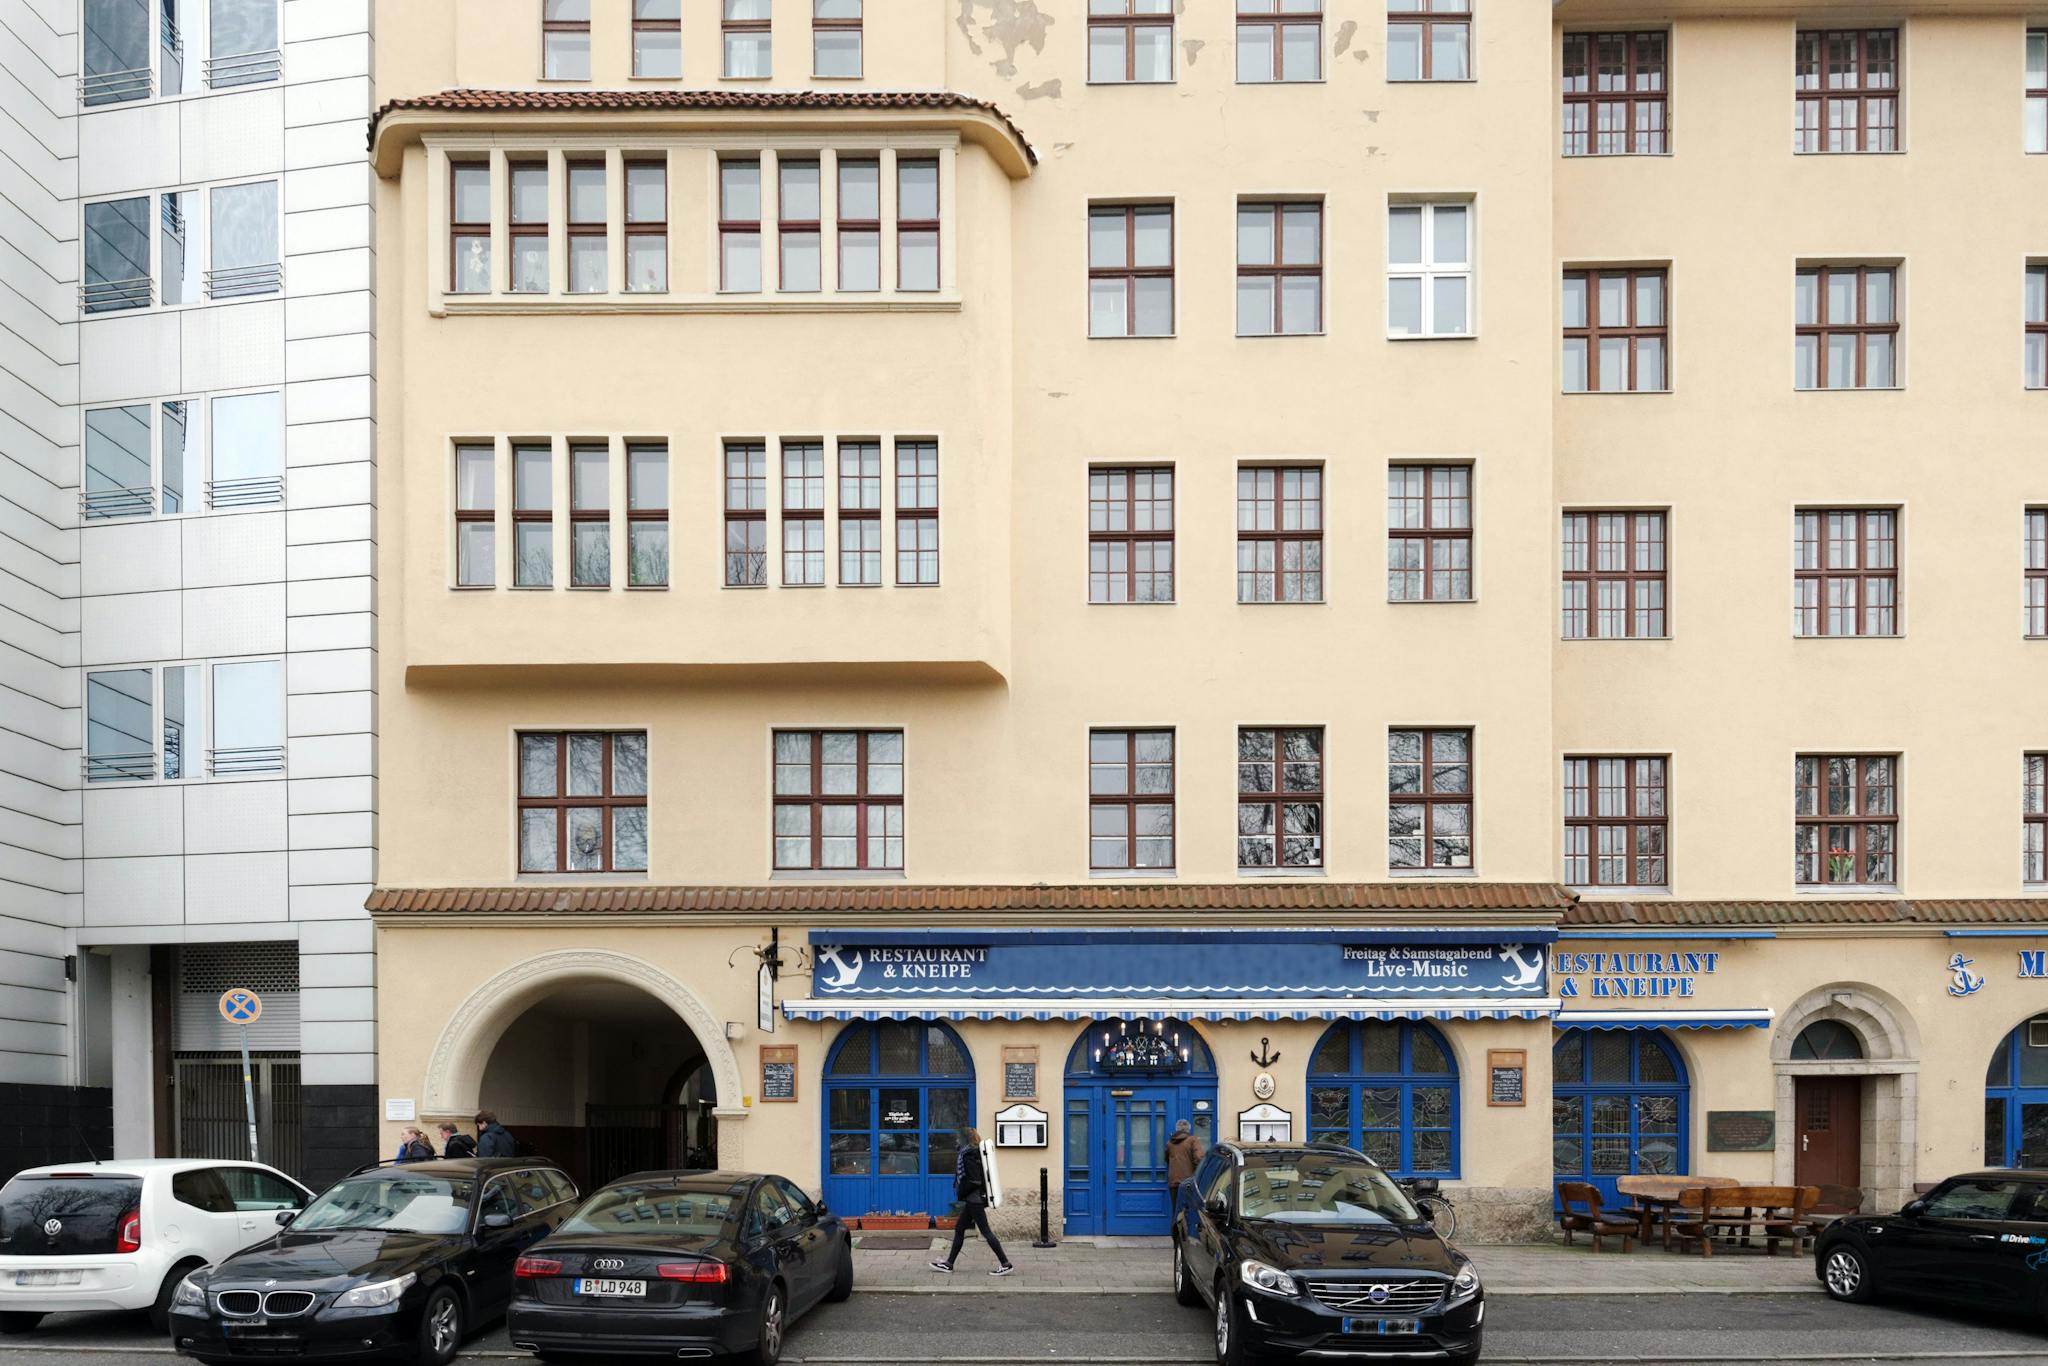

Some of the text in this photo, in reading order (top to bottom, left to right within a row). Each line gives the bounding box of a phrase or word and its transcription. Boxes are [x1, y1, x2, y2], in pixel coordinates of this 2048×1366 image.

[869, 948, 988, 962] RESTAURANT
[1343, 946, 1492, 961] Freitag & Samstagabend
[1367, 960, 1468, 977] Live-Music
[1552, 951, 1719, 974] ESTAURANT
[2019, 950, 2048, 978] M
[883, 964, 972, 978] & KNEIPE
[1560, 977, 1695, 998] & KNEIPE
[584, 1280, 642, 1294] B LD 948
